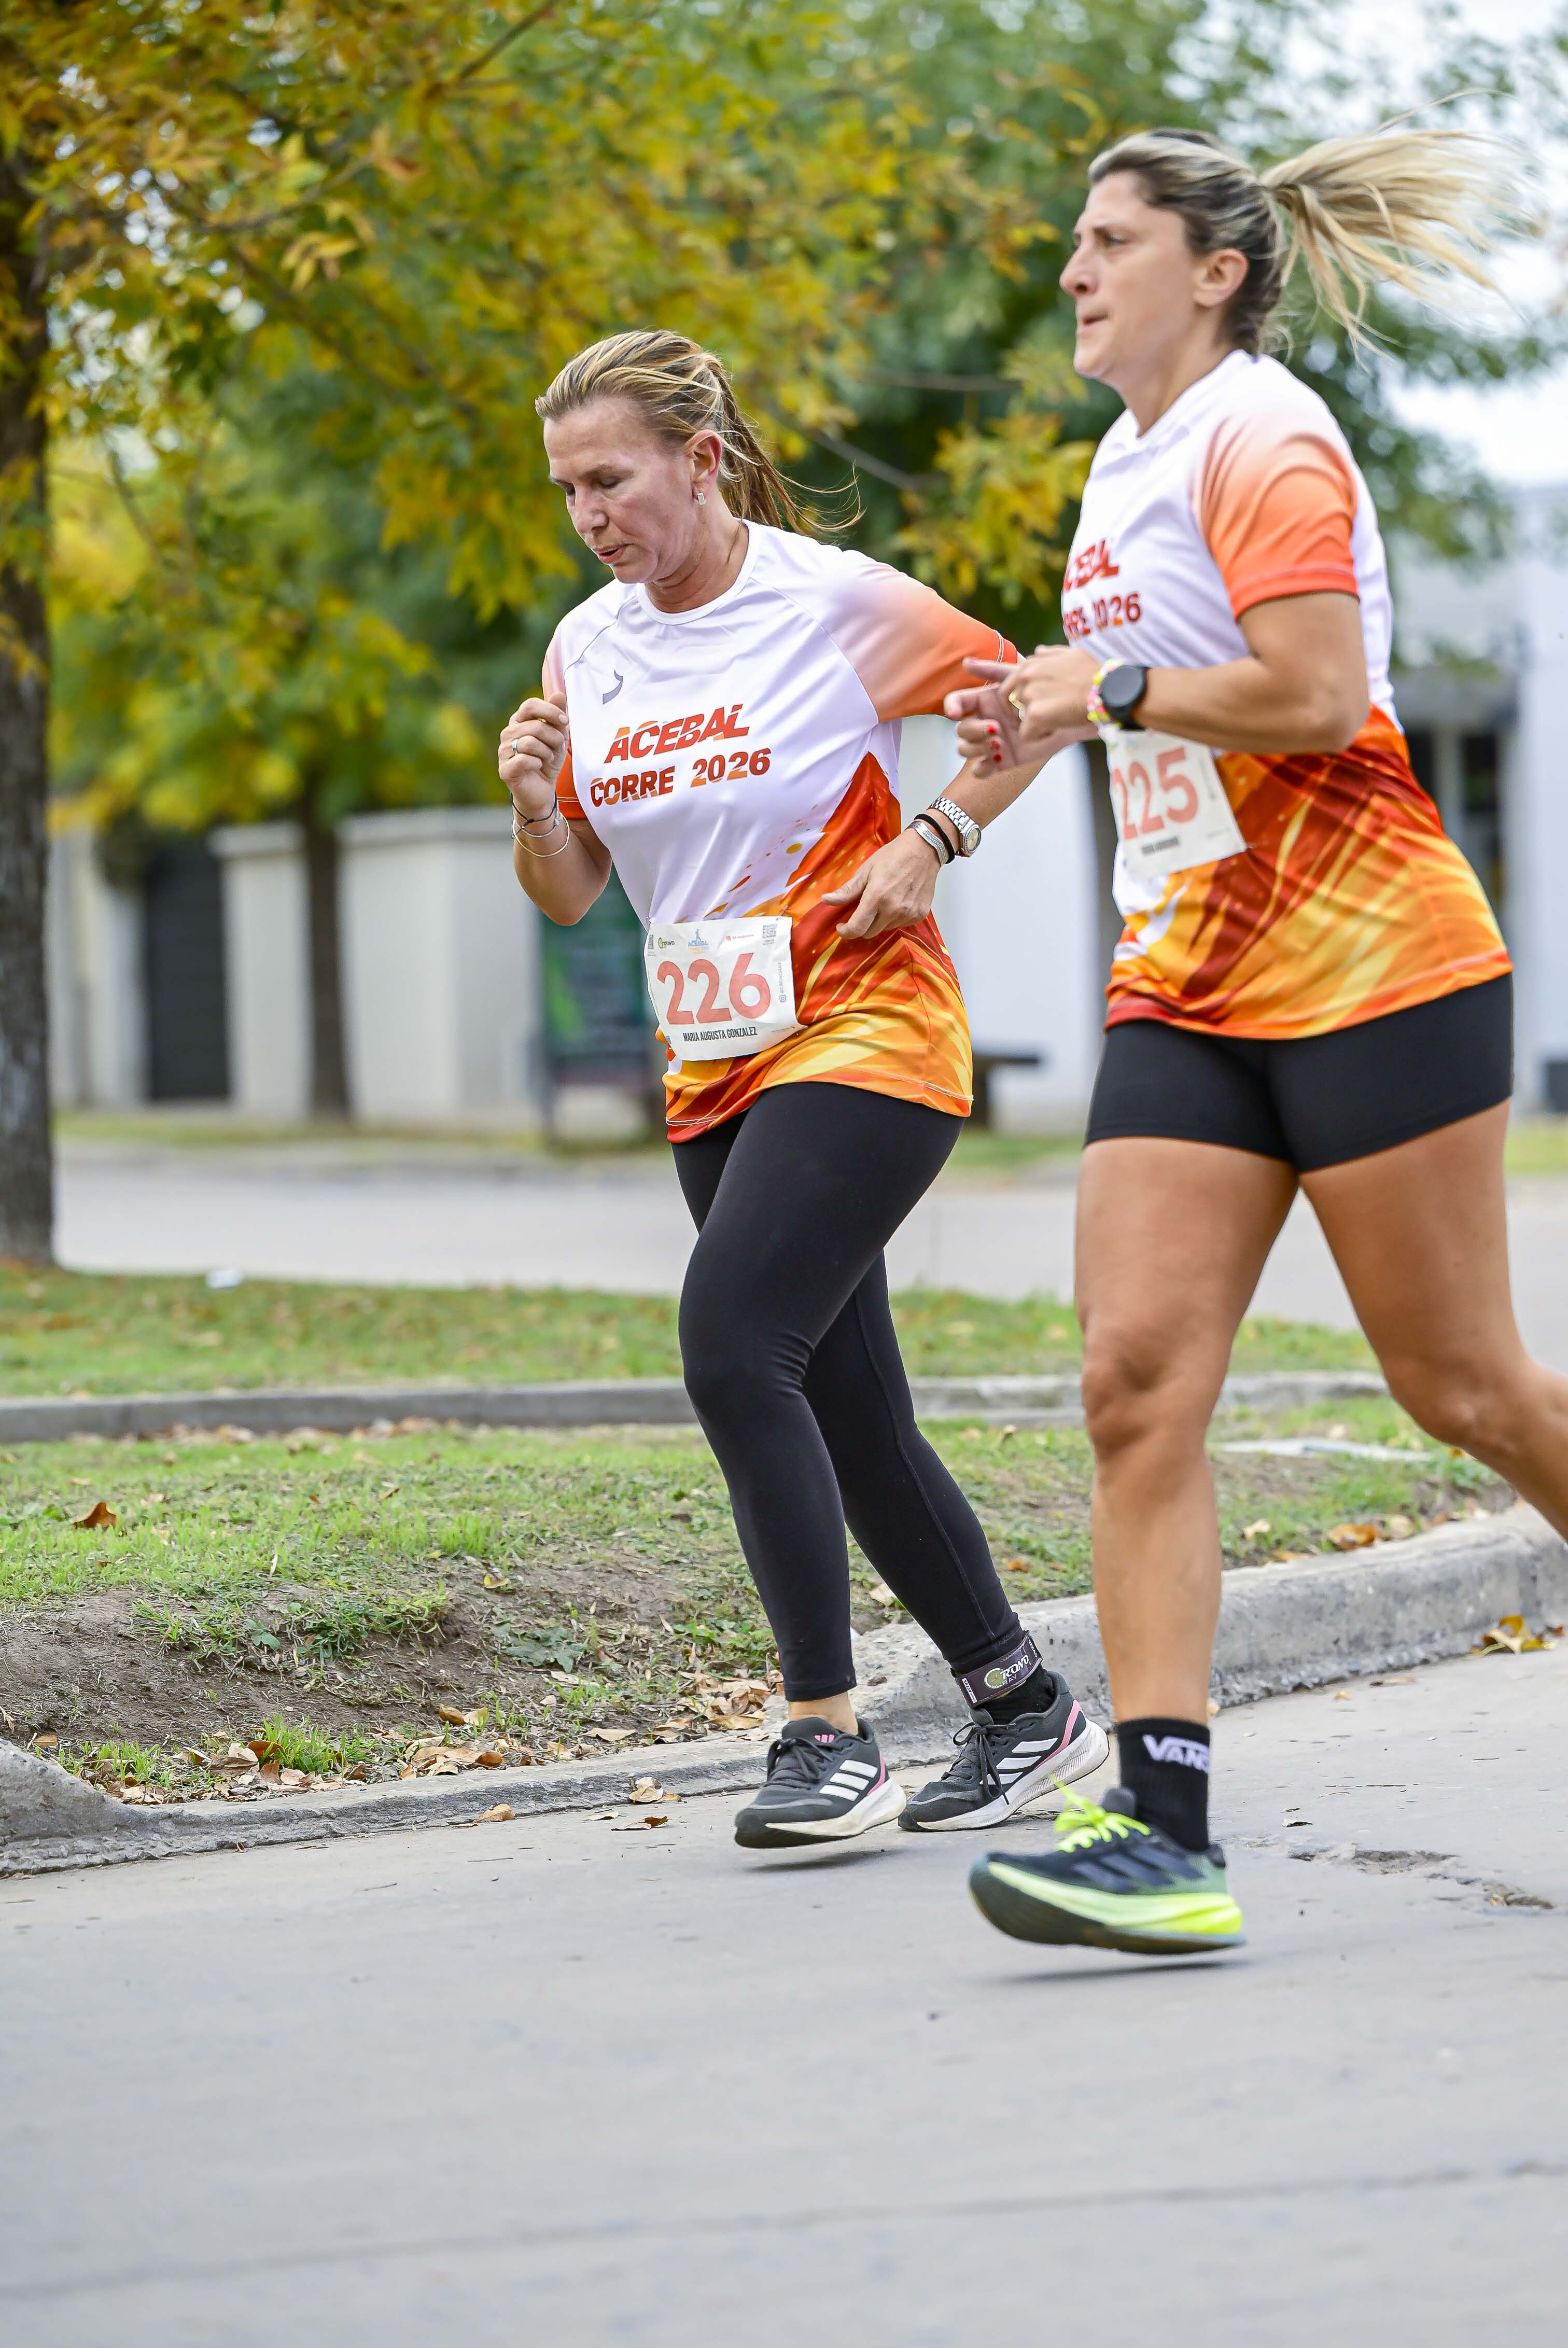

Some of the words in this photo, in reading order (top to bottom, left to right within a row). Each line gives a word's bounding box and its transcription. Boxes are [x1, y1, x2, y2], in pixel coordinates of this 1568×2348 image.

[603, 704, 750, 764] ACEBAL
[590, 765, 675, 807] CORRE
[690, 748, 772, 788] 2026
[1112, 747, 1199, 841] 225
[657, 952, 771, 1025] 226
[682, 1032, 700, 1042] MARIA
[700, 1030, 726, 1041] AUGUSTA
[726, 1026, 758, 1038] GONZALEZ
[1002, 1674, 1017, 1685] RAV
